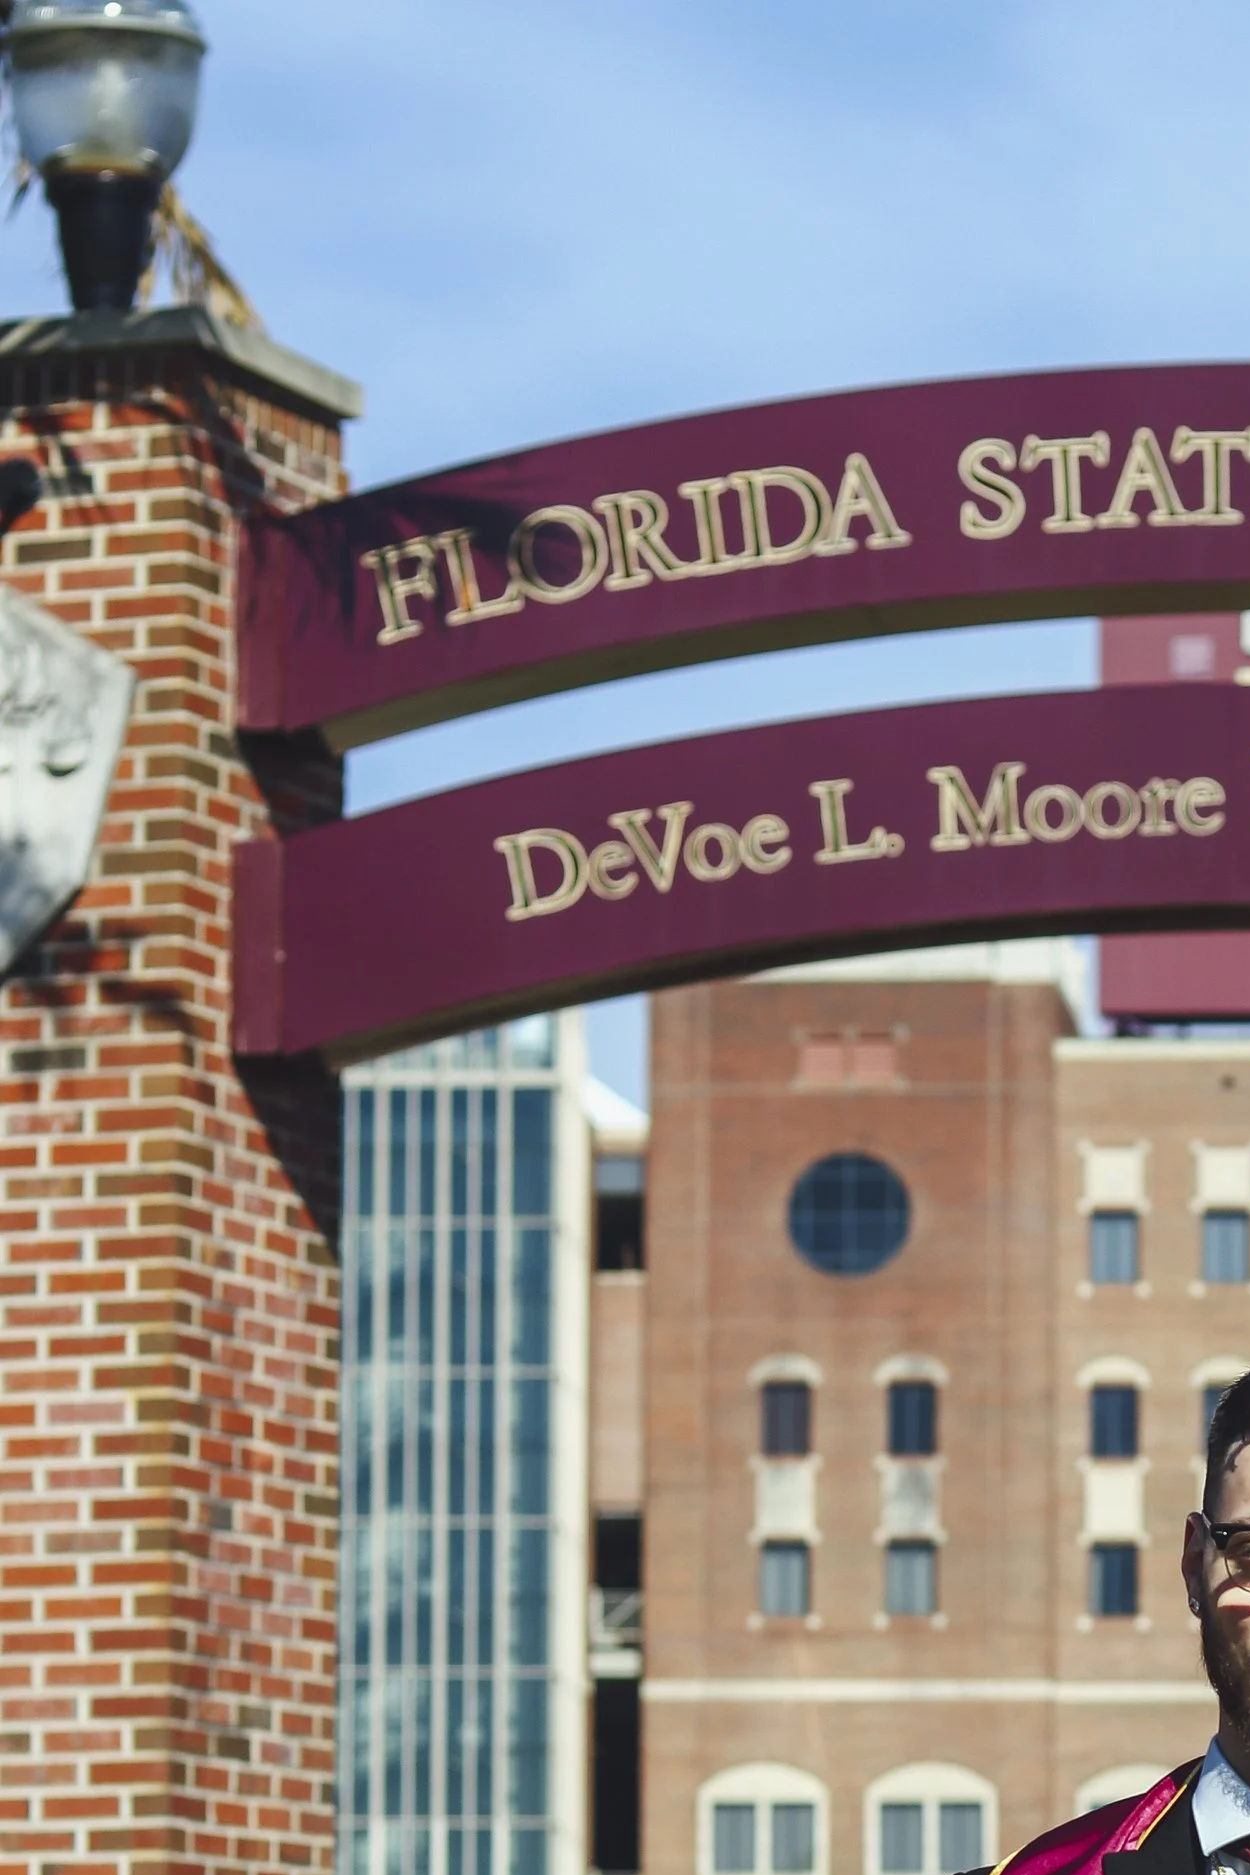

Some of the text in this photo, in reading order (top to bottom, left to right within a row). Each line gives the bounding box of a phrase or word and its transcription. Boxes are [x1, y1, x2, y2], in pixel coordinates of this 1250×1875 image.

[361, 452, 913, 646] FLORIDA
[493, 801, 791, 921] DeVoe
[808, 778, 905, 865] L.
[926, 761, 1227, 852] Moore
